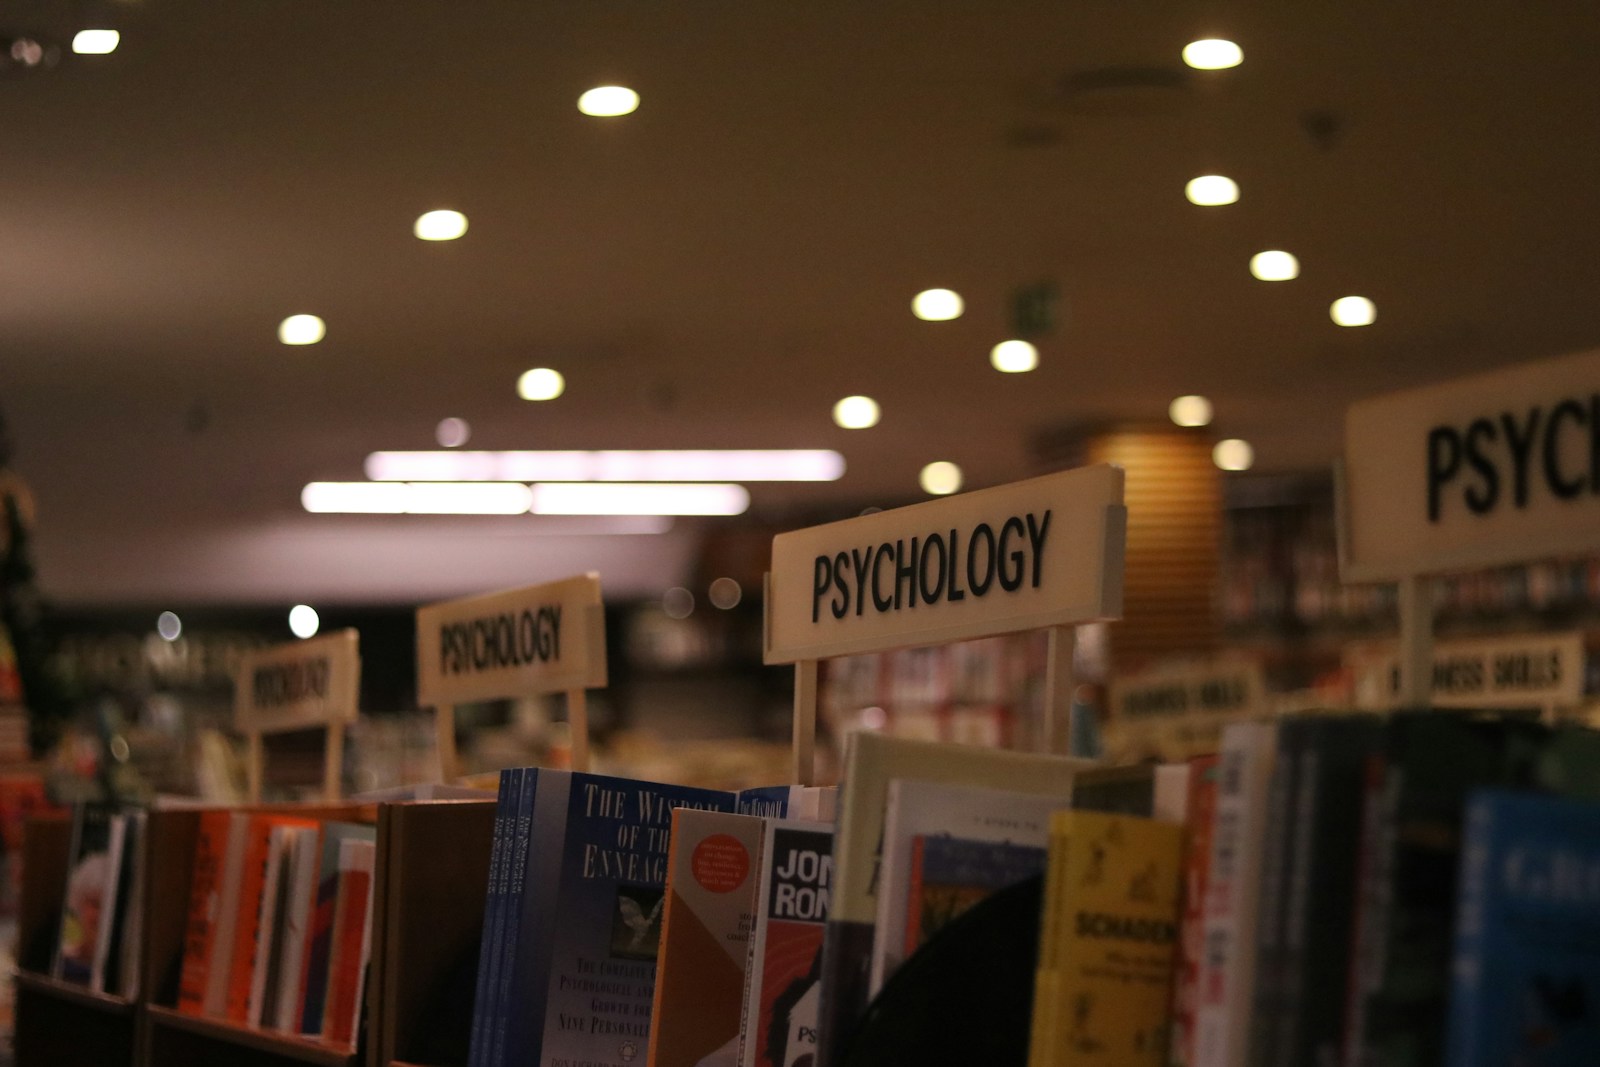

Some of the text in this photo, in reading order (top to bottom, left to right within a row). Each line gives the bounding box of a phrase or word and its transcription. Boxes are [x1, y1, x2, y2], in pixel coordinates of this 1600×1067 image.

[1428, 395, 1600, 522] PSYC
[812, 510, 1051, 623] PSYCHOLOGY
[440, 606, 562, 677] PSYCHOLOGY
[584, 783, 627, 819] THE
[617, 824, 640, 850] OF
[559, 1013, 585, 1031] NINE
